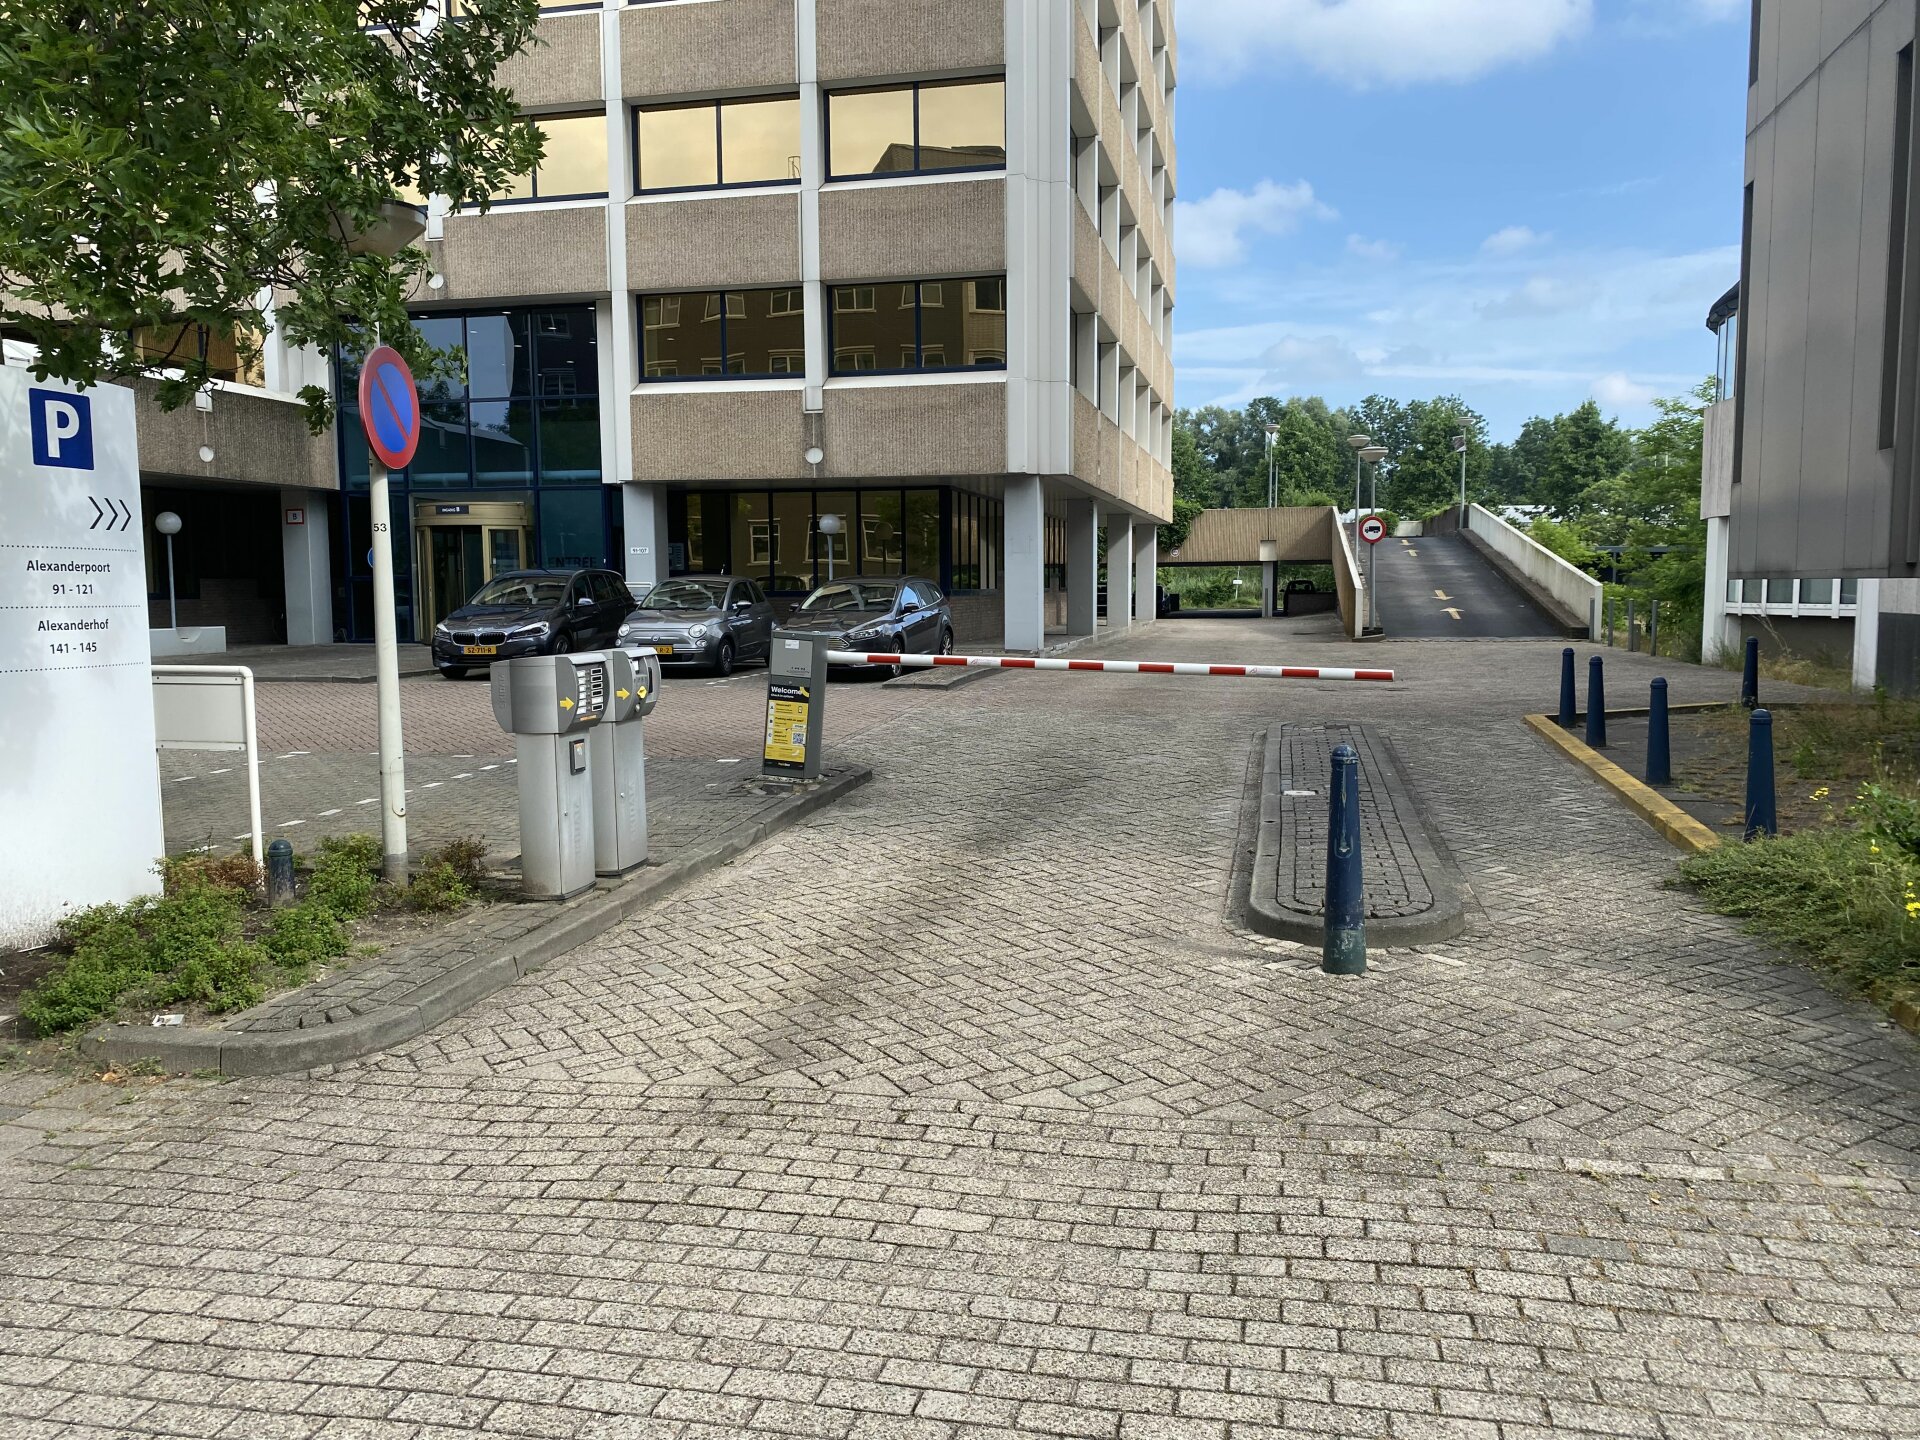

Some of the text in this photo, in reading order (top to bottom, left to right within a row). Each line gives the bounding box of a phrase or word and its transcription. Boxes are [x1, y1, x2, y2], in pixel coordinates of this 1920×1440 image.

[44, 399, 80, 458] P
[373, 522, 387, 532] 53
[26, 559, 111, 575] Alexanderpoort
[52, 584, 66, 595] 91
[75, 584, 93, 595] 121
[37, 618, 109, 632] Alexanderhof
[49, 643, 69, 654] 141
[79, 642, 97, 653] 145
[770, 686, 803, 695] Welcome
